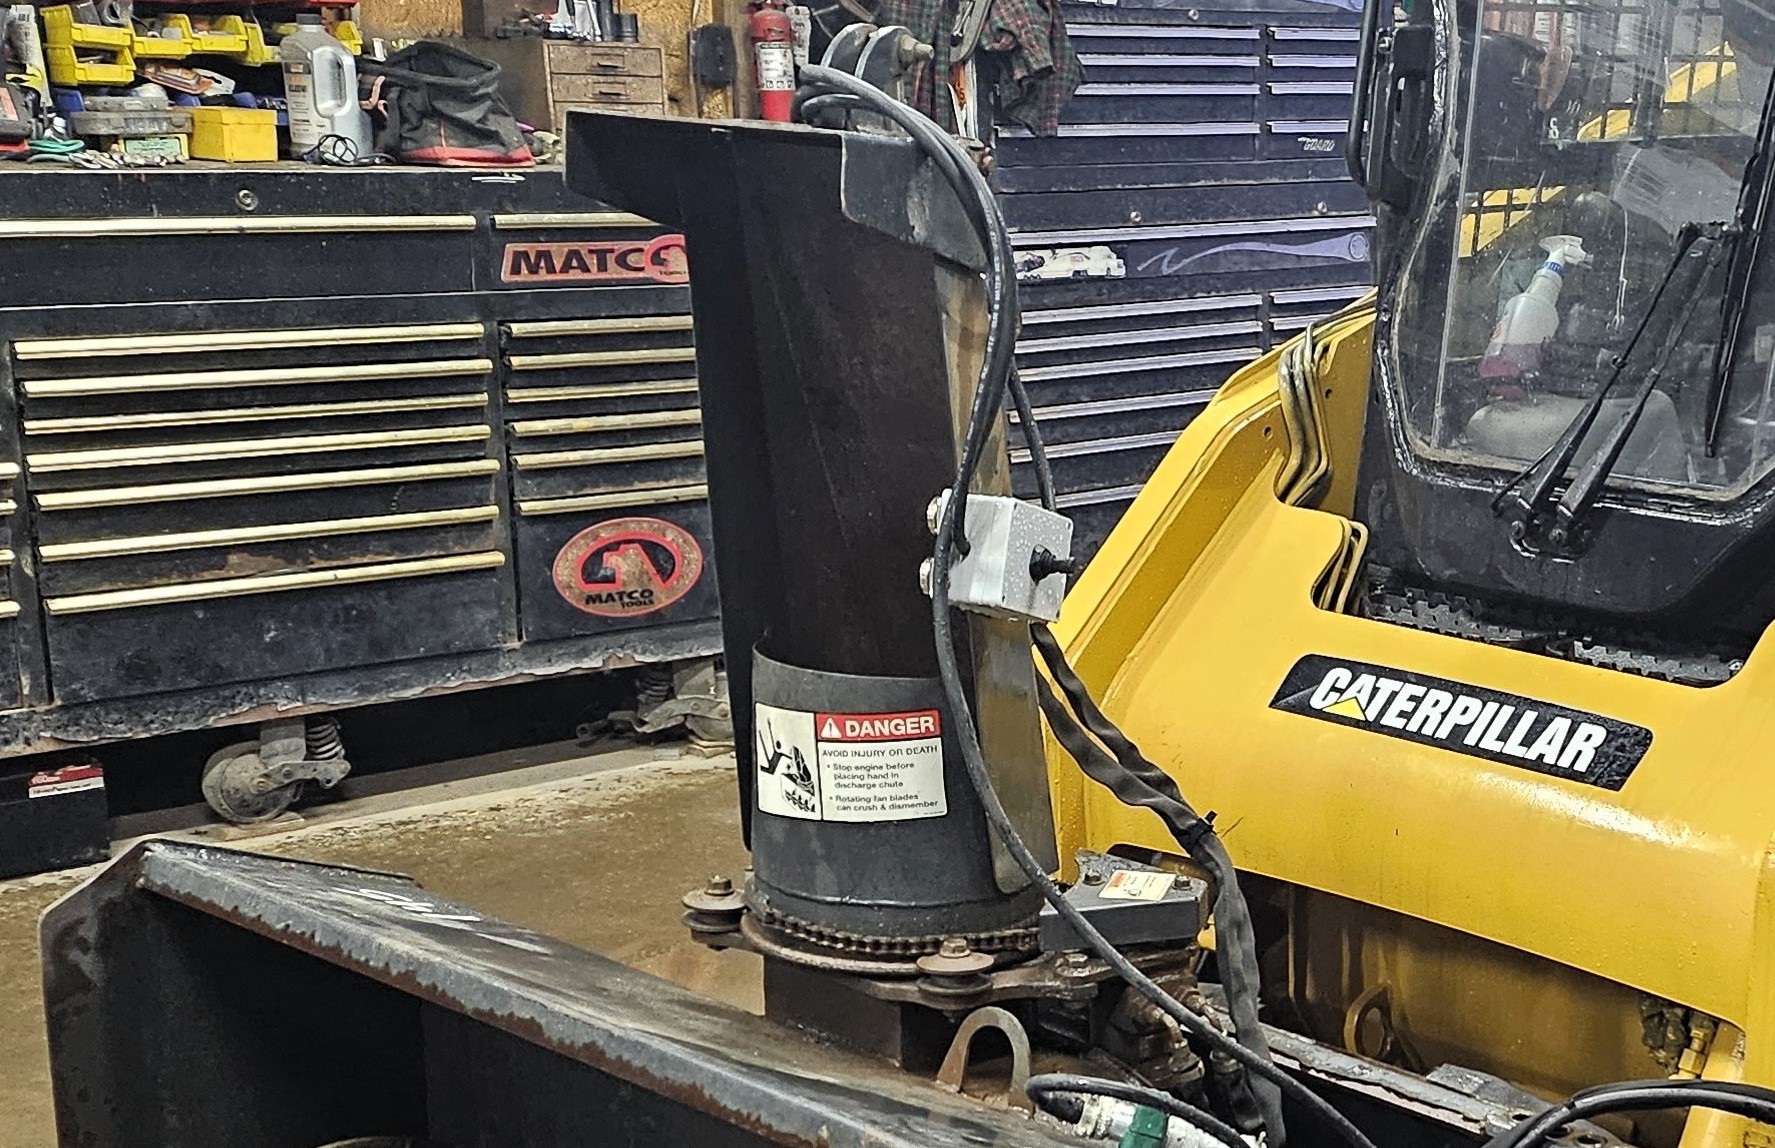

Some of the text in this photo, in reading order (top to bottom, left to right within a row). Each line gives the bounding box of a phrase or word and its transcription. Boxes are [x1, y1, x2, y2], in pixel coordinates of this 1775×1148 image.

[584, 588, 654, 606] MATCO
[1309, 667, 1608, 773] CATERPILLAR
[845, 716, 935, 738] DANGER
[851, 749, 885, 757] INJURY
[888, 748, 903, 757] OR
[906, 745, 938, 755] DEATH
[854, 763, 884, 772] engine
[886, 762, 914, 770] before
[867, 772, 889, 780] hand
[891, 771, 899, 779] in
[834, 780, 903, 790] discharge chute
[835, 795, 871, 803] Rotating
[889, 793, 919, 801] blades
[853, 803, 878, 811] crush
[880, 803, 887, 811] &
[888, 800, 938, 810] dismember
